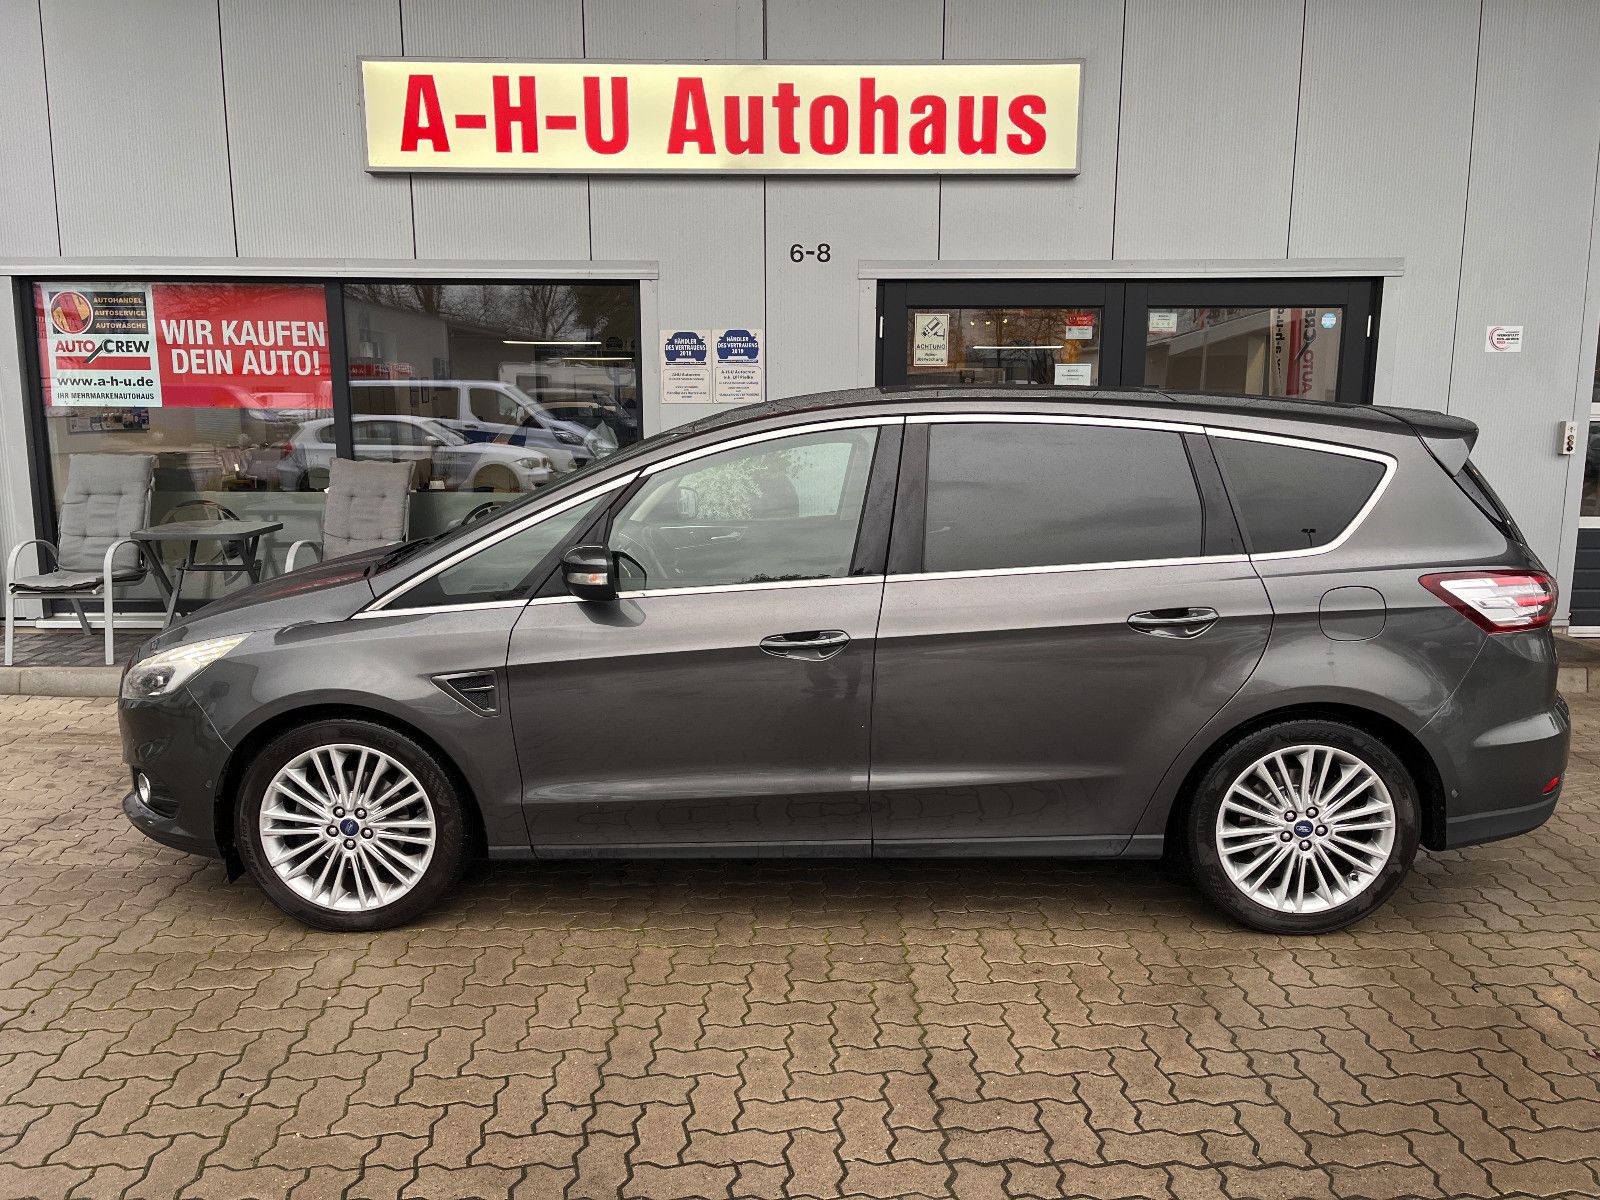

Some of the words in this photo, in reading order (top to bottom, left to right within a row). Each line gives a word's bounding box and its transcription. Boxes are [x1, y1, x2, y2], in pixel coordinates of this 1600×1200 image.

[400, 74, 630, 155] A-H-U
[666, 77, 1048, 156] Autohaus
[790, 243, 831, 263] 6-8
[160, 319, 214, 345] WIR
[221, 320, 326, 347] KAUFEN
[55, 340, 96, 353] AUTO
[102, 339, 150, 354] CREW
[171, 349, 234, 375] DEIN
[241, 350, 321, 376] AUTO!
[57, 376, 154, 387] www.a-h-u.de
[71, 392, 155, 400] MEHRMARKENAUTOHAUS
